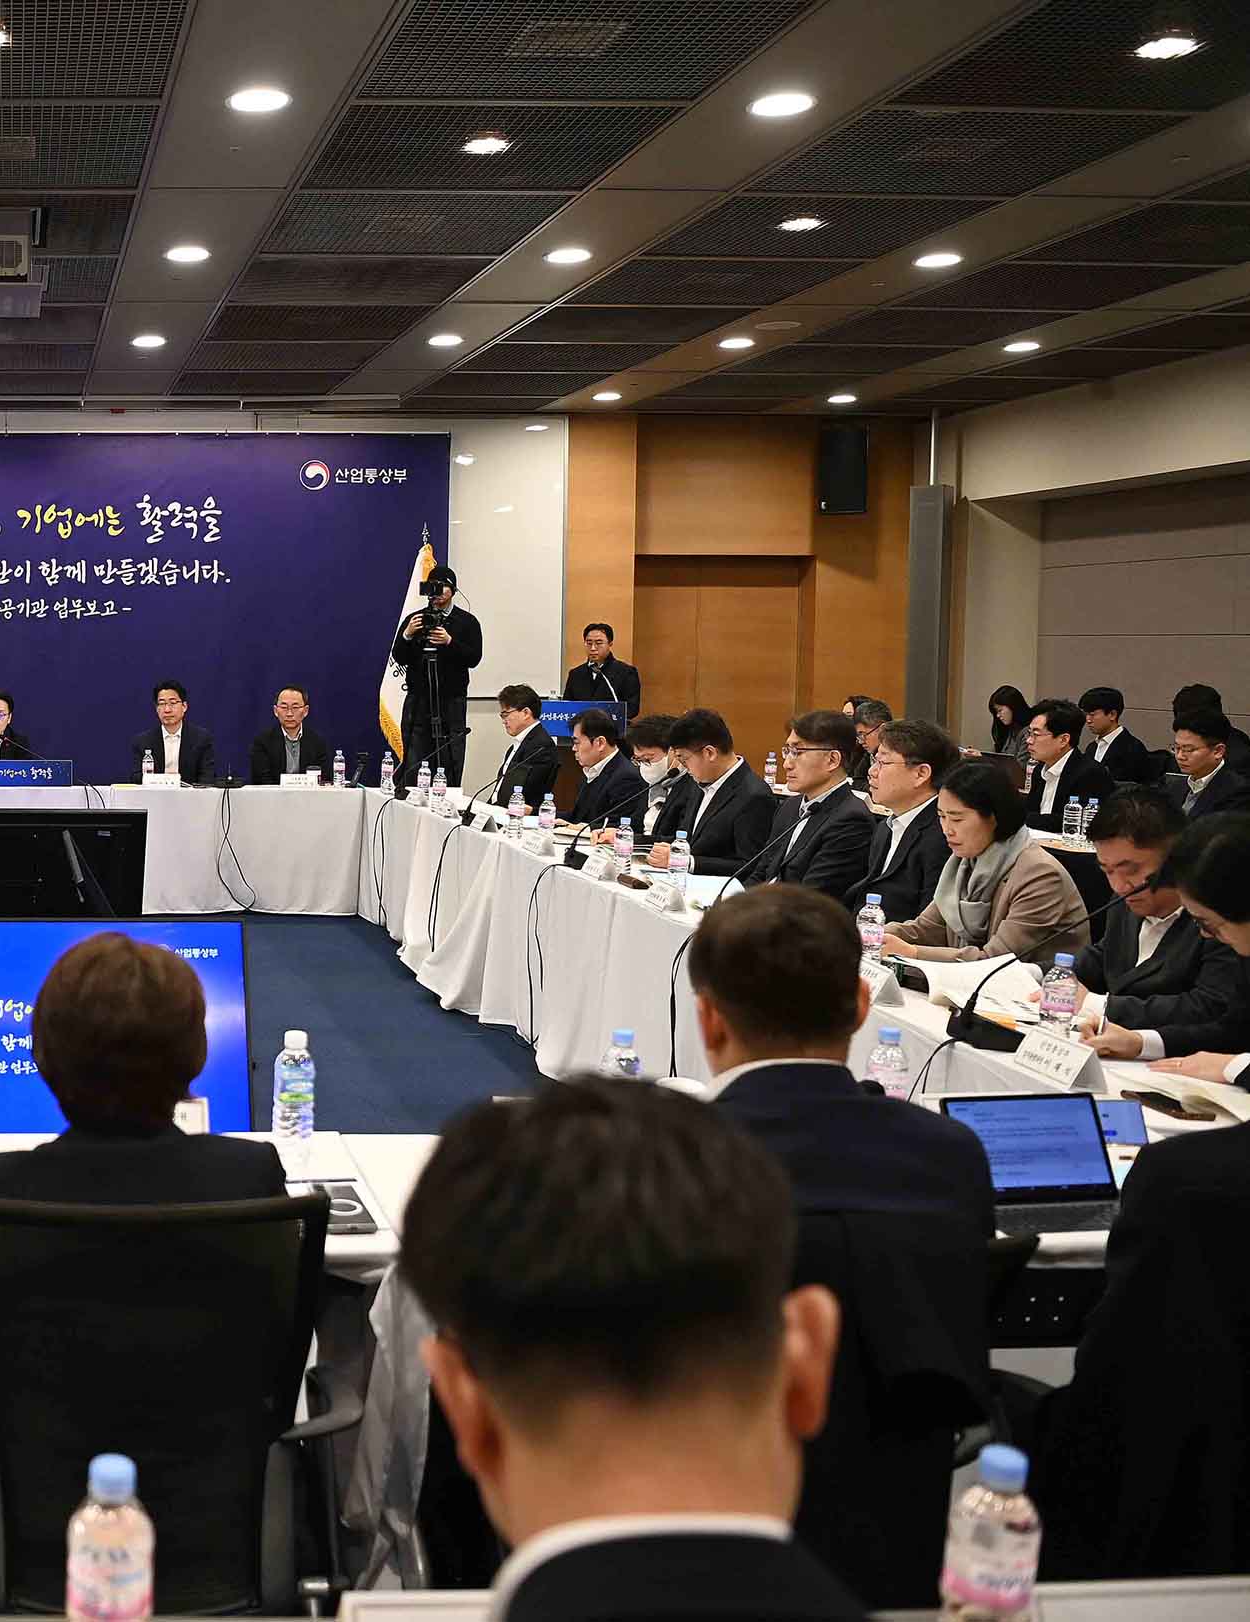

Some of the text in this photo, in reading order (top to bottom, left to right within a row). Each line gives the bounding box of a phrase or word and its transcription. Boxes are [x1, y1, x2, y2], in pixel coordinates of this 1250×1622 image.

[334, 468, 407, 485] 산업통상부
[16, 503, 126, 539] 기업에는
[135, 493, 223, 544] 활력을
[37, 558, 87, 587] 함께
[93, 557, 231, 587] 만들겠습니다.
[0, 1033, 33, 1052] 함께
